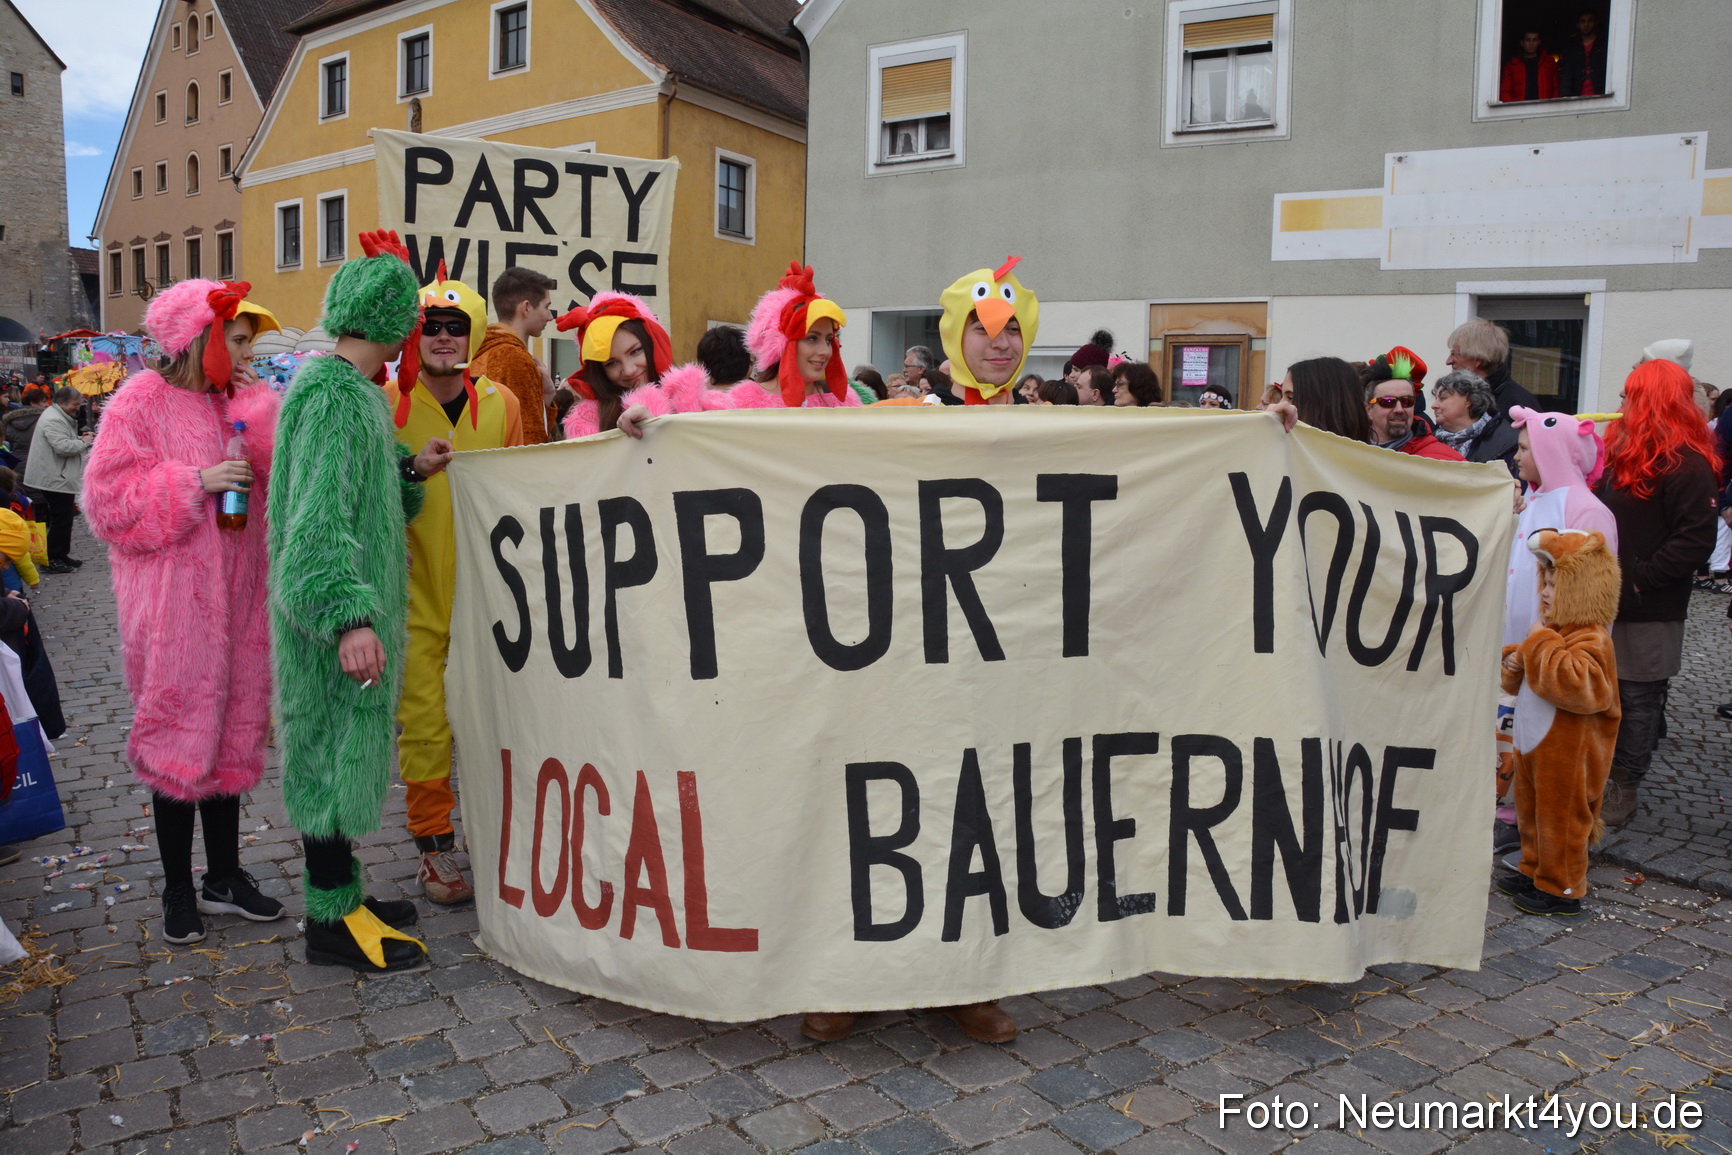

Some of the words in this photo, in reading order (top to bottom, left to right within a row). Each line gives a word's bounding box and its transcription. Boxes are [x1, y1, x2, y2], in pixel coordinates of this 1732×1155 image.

[404, 146, 661, 242] PARTY
[490, 474, 1118, 680] SUPPORT
[1228, 472, 1479, 676] YOUR
[499, 748, 759, 952] LOCAL
[845, 732, 1436, 942] BAUERNHOF
